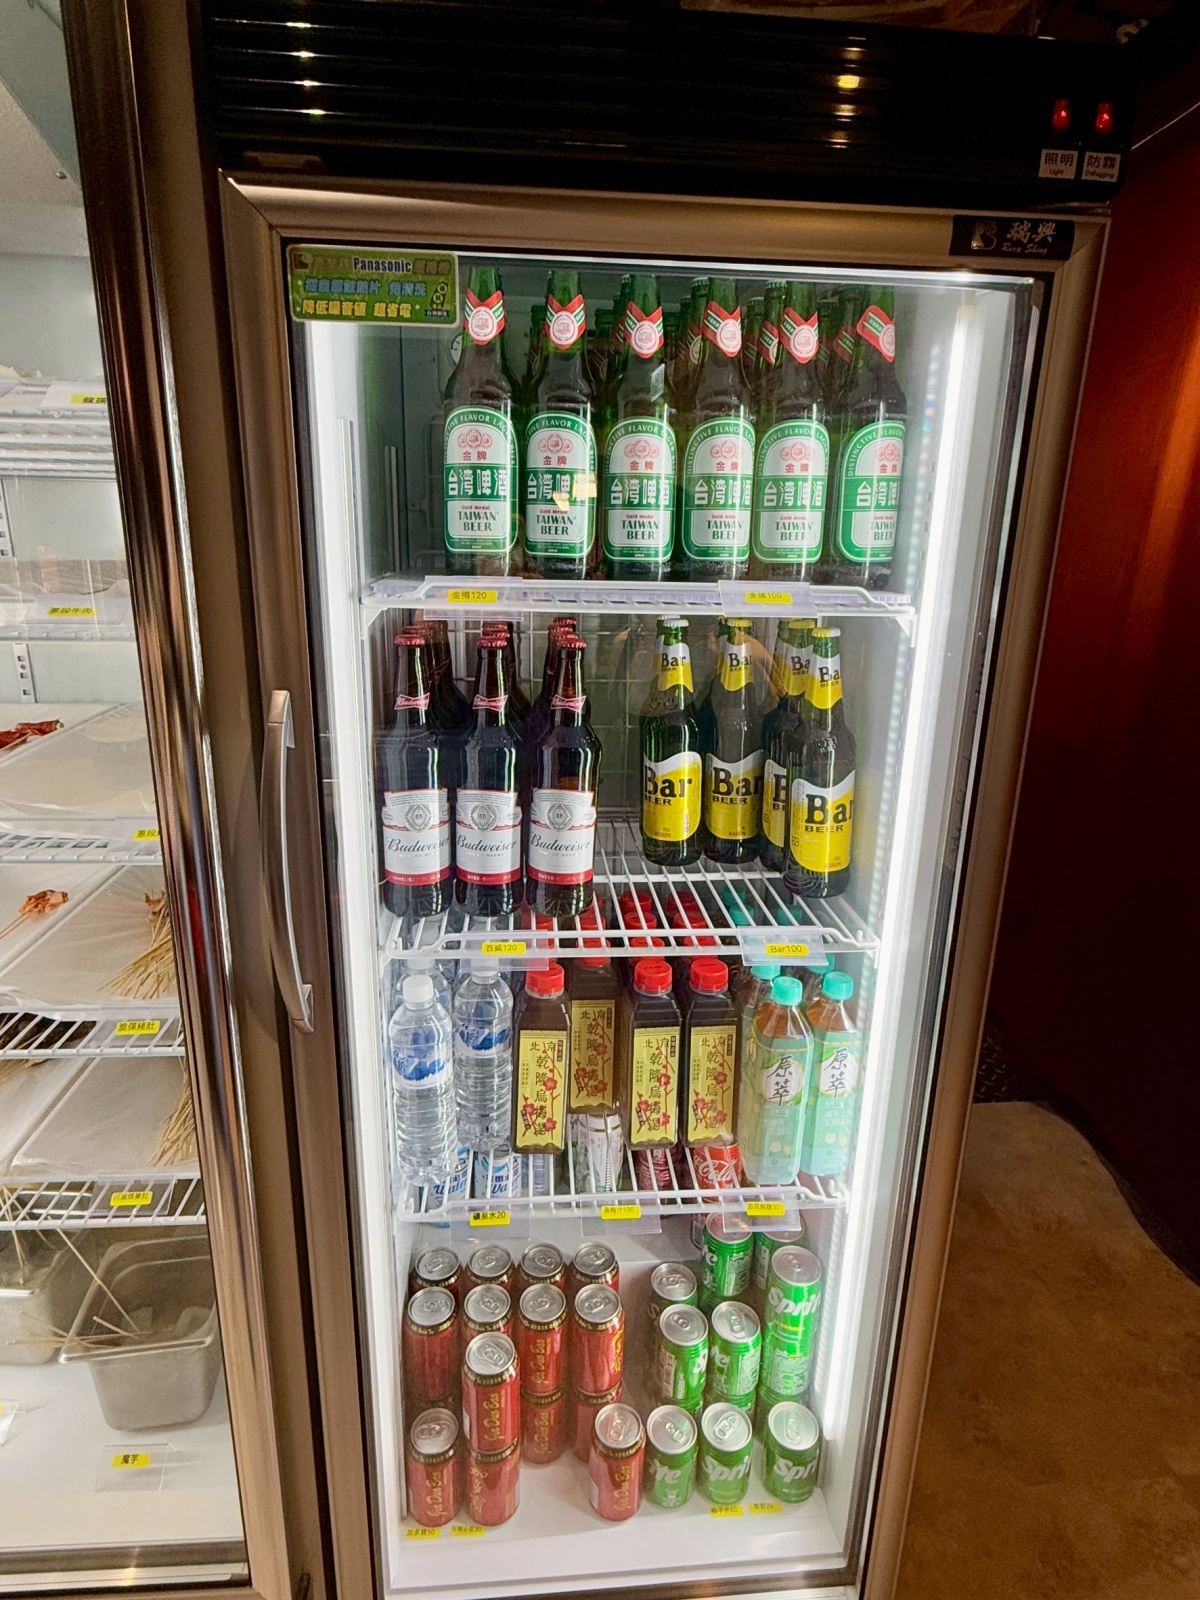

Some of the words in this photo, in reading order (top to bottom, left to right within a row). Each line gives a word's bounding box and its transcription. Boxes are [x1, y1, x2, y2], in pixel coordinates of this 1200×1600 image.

[1044, 153, 1074, 166] 照明
[1087, 155, 1117, 169] 防霧
[353, 257, 412, 272] Panasonic
[460, 414, 490, 423] FLAVOR
[541, 418, 572, 427] FLAVOR
[462, 450, 487, 462] 金牌
[543, 455, 567, 466] 金牌
[629, 460, 654, 471] 金牌
[785, 463, 810, 473] 金牌
[458, 511, 496, 521] TAIWAN
[536, 514, 574, 525] TAIWAN
[463, 522, 492, 531] BEER
[541, 525, 569, 535] BEER
[621, 520, 660, 530] TAIWAN
[627, 530, 655, 540] BEER
[452, 591, 487, 600] 金樽120
[661, 652, 687, 668] Bar
[791, 656, 811, 671] Ba
[643, 764, 692, 799] Bar
[712, 796, 749, 805] BEER
[804, 824, 844, 834] BEER
[456, 832, 517, 852] Budweiser
[530, 832, 591, 852] Budweiser
[486, 944, 518, 953] 百威120
[770, 944, 803, 954] Bar100
[581, 1009, 606, 1020] 北京
[530, 1041, 557, 1052] 北京
[644, 1037, 670, 1049] 北京
[701, 1036, 727, 1047] 北京
[823, 1048, 849, 1098] 原萃
[767, 1055, 793, 1106] 原萃
